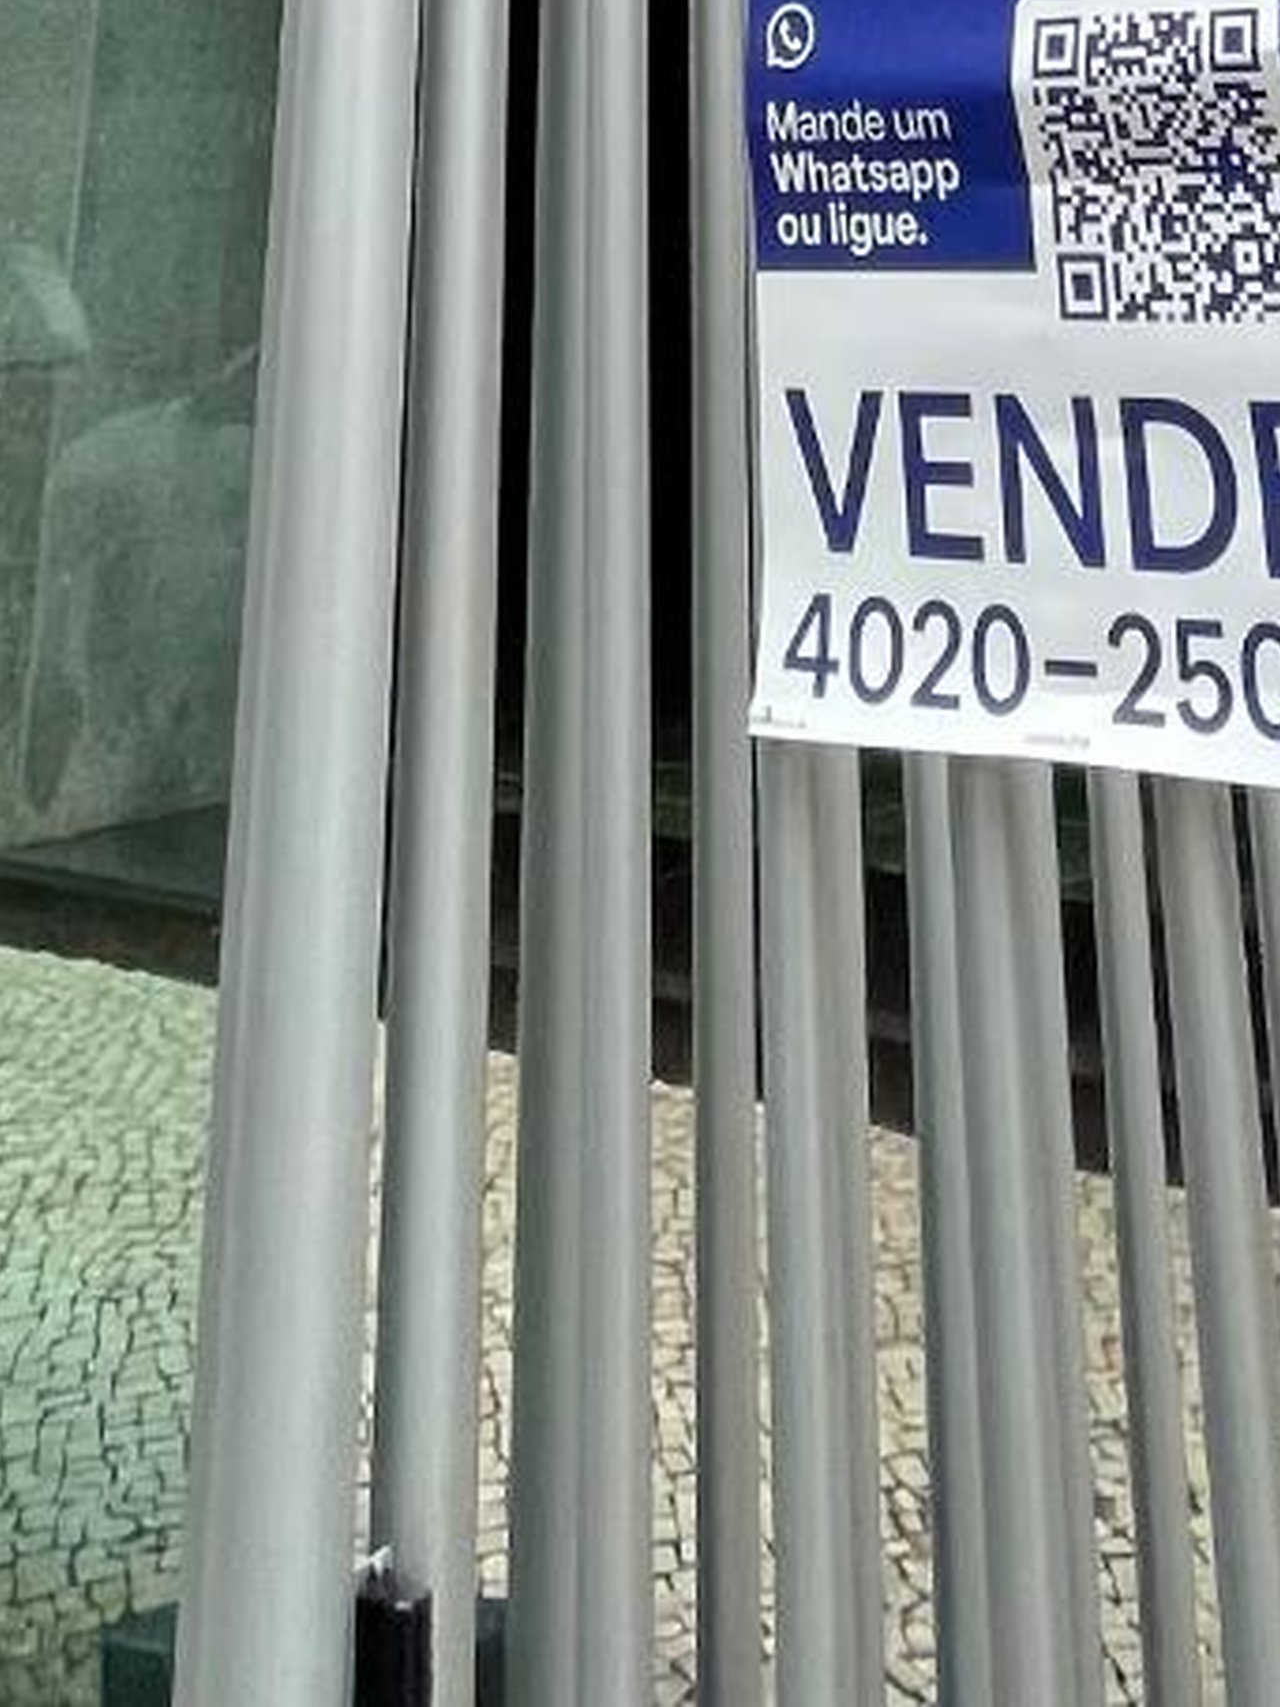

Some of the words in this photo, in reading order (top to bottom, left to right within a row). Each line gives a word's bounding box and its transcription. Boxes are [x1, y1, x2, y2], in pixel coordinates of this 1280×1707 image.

[766, 99, 885, 142] Mande
[893, 109, 952, 141] um
[769, 150, 960, 201] Whatsapp
[777, 212, 821, 246] ou
[827, 200, 928, 256] ligue.
